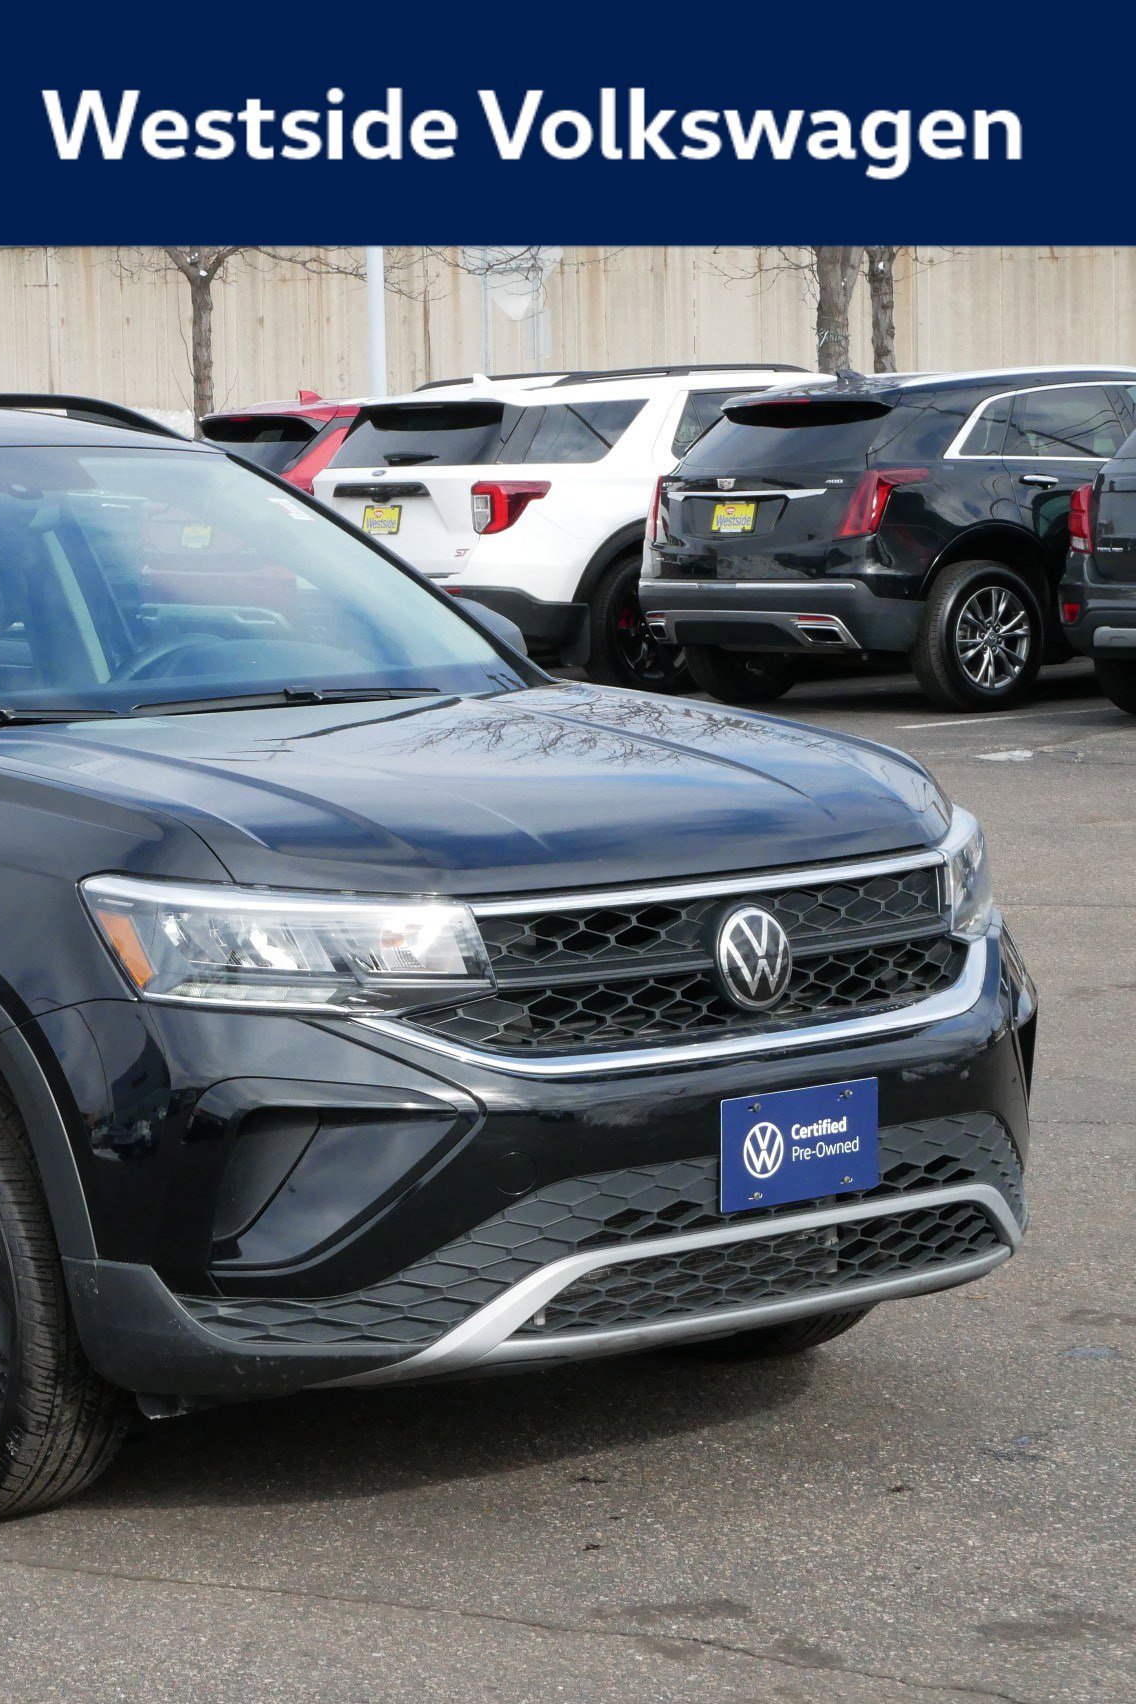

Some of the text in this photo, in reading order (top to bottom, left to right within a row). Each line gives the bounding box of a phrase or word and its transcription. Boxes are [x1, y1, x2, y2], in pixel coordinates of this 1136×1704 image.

[366, 517, 397, 529] Westside
[715, 514, 752, 528] Westside
[454, 548, 470, 558] ST
[791, 1116, 847, 1140] Certified
[792, 1136, 860, 1162] Pre-Owned
